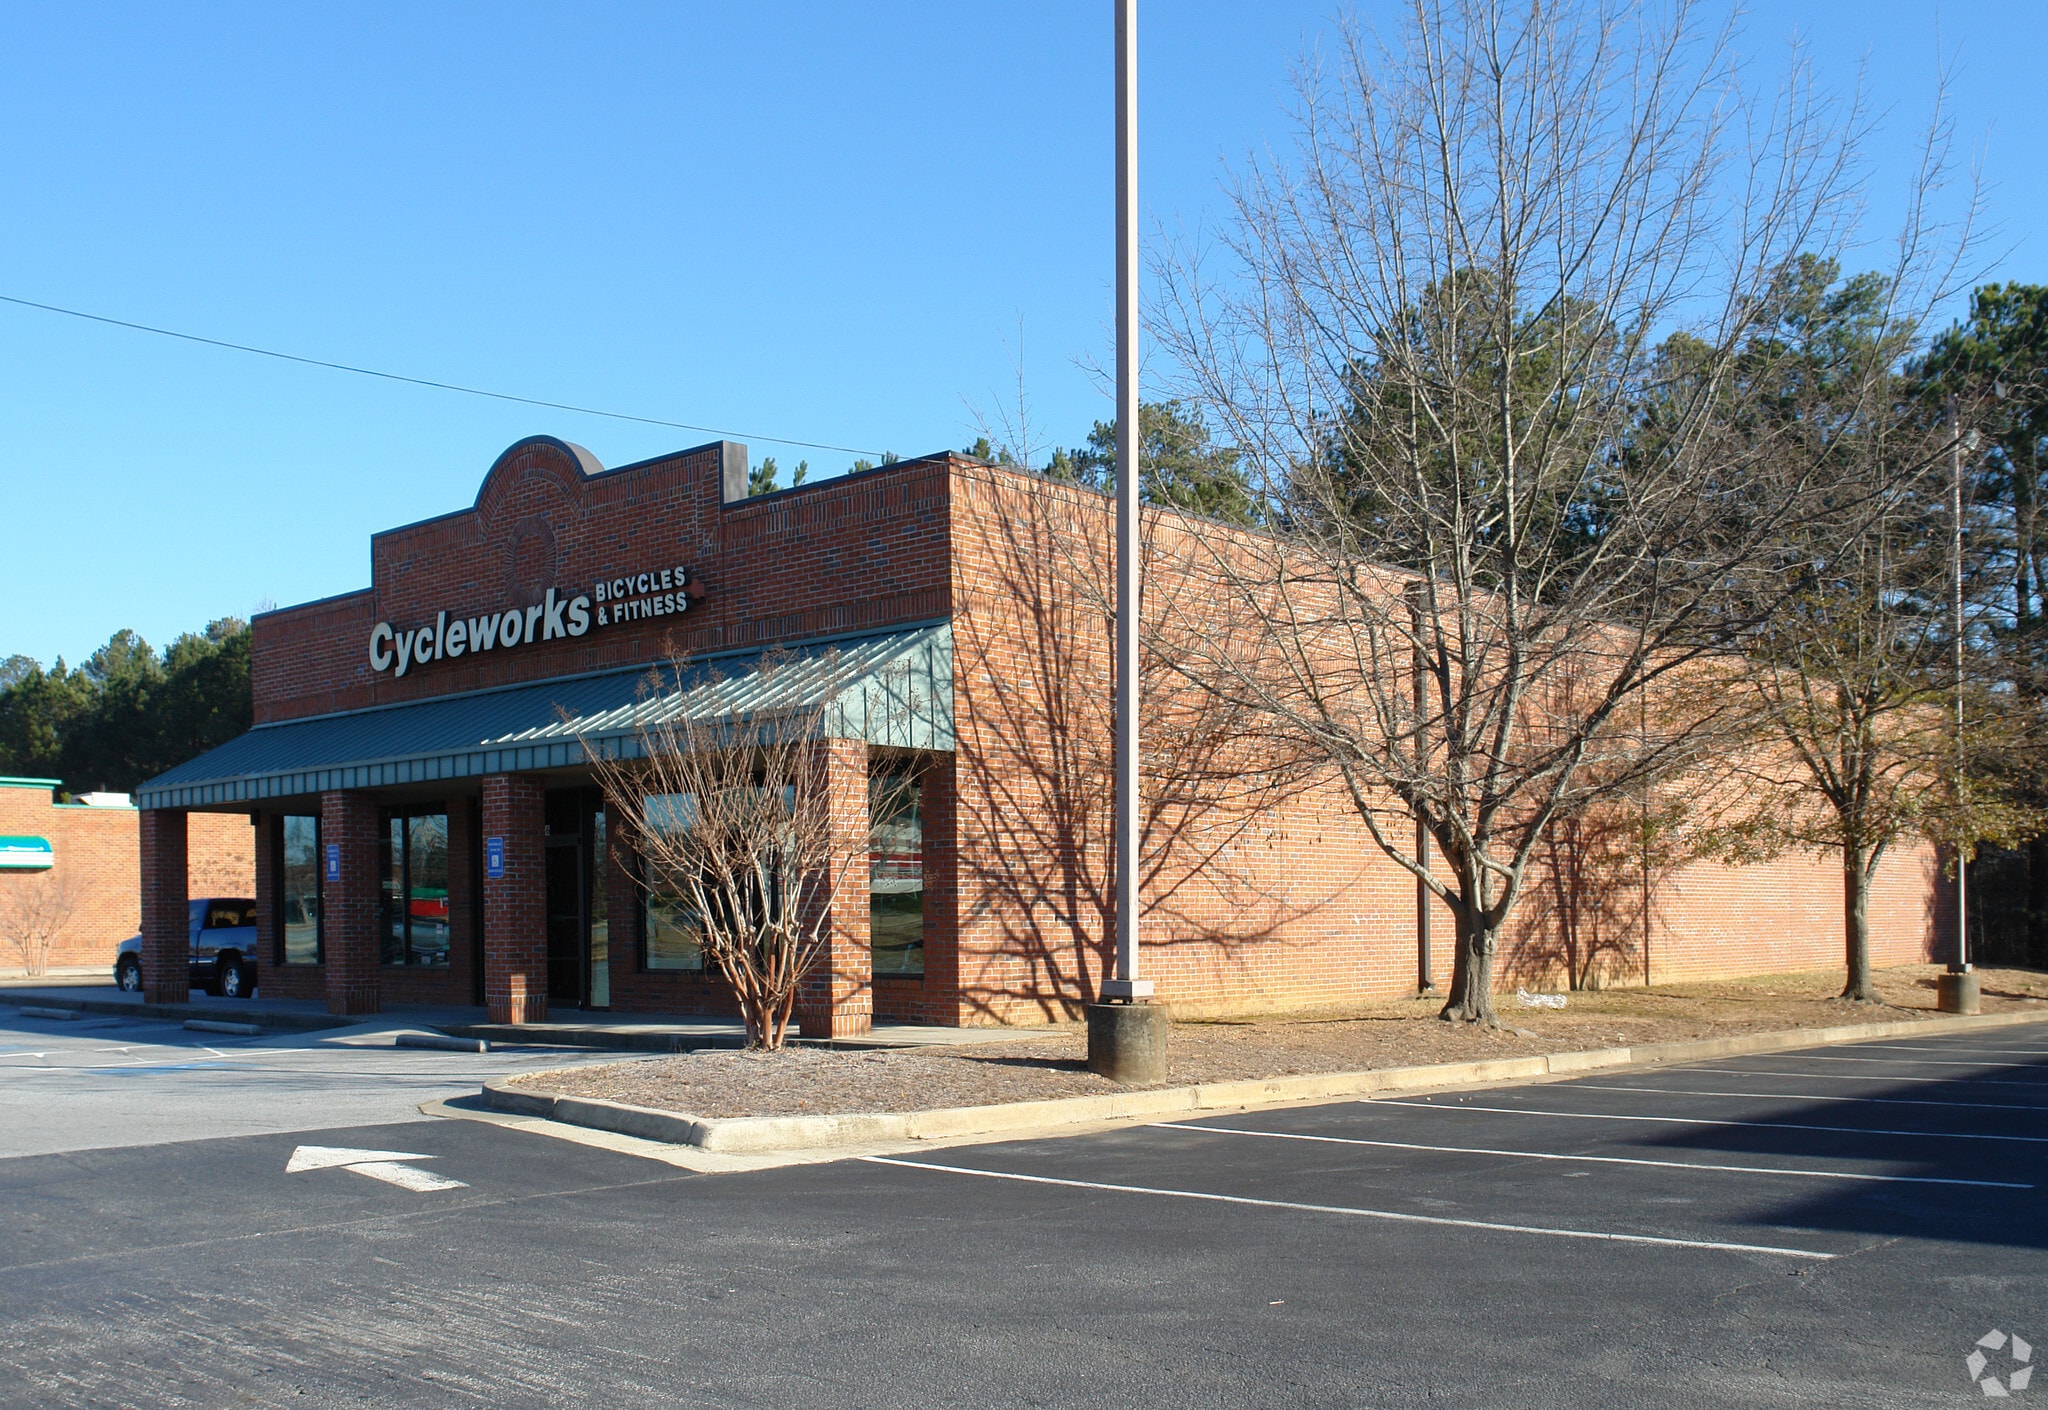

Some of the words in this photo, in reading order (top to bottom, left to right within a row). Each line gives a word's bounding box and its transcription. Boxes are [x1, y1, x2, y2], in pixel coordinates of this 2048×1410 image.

[595, 567, 686, 602] BICYCLES
[597, 606, 609, 626] &
[613, 591, 687, 623] FITNESS
[369, 588, 590, 677] Cycleworks
